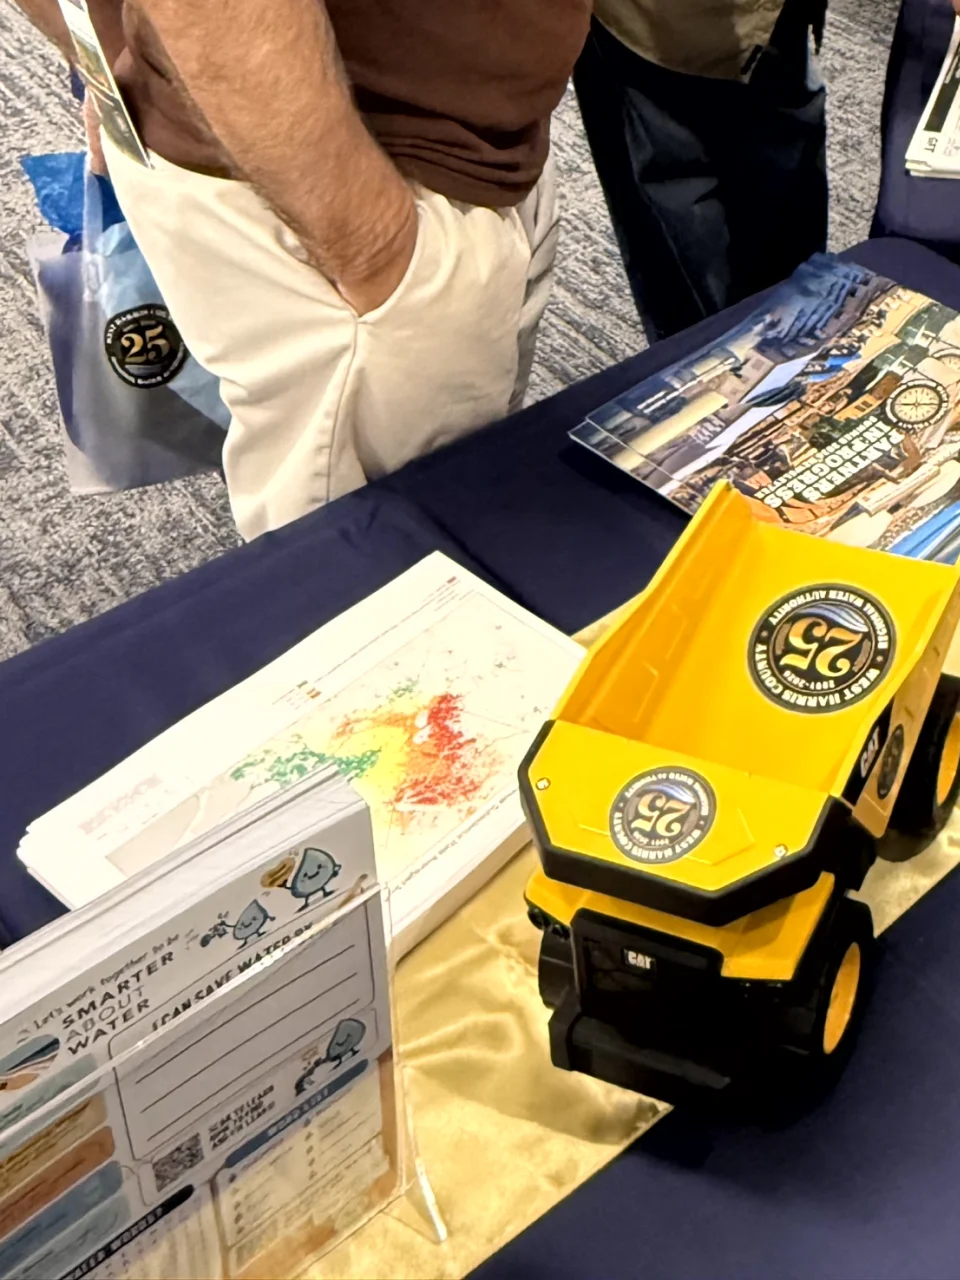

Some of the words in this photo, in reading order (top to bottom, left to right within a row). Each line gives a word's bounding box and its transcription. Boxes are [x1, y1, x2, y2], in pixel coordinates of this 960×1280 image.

[121, 325, 171, 363] 25
[862, 420, 892, 439] IN
[764, 437, 870, 508] PROGRESS
[802, 428, 905, 503] PARTNERS
[768, 590, 827, 626] AUTHORITY
[755, 643, 783, 695] COUNTY
[779, 617, 864, 678] 25
[782, 690, 840, 707] HARRIS
[844, 668, 880, 696] WEST
[631, 792, 691, 837] 25
[66, 986, 96, 1007] work
[100, 952, 148, 986] together
[627, 949, 652, 970] CAT
[62, 951, 174, 1030] SMARTER
[66, 986, 145, 1043] ABOUT
[160, 998, 192, 1025] CAN
[68, 998, 151, 1056] WATER
